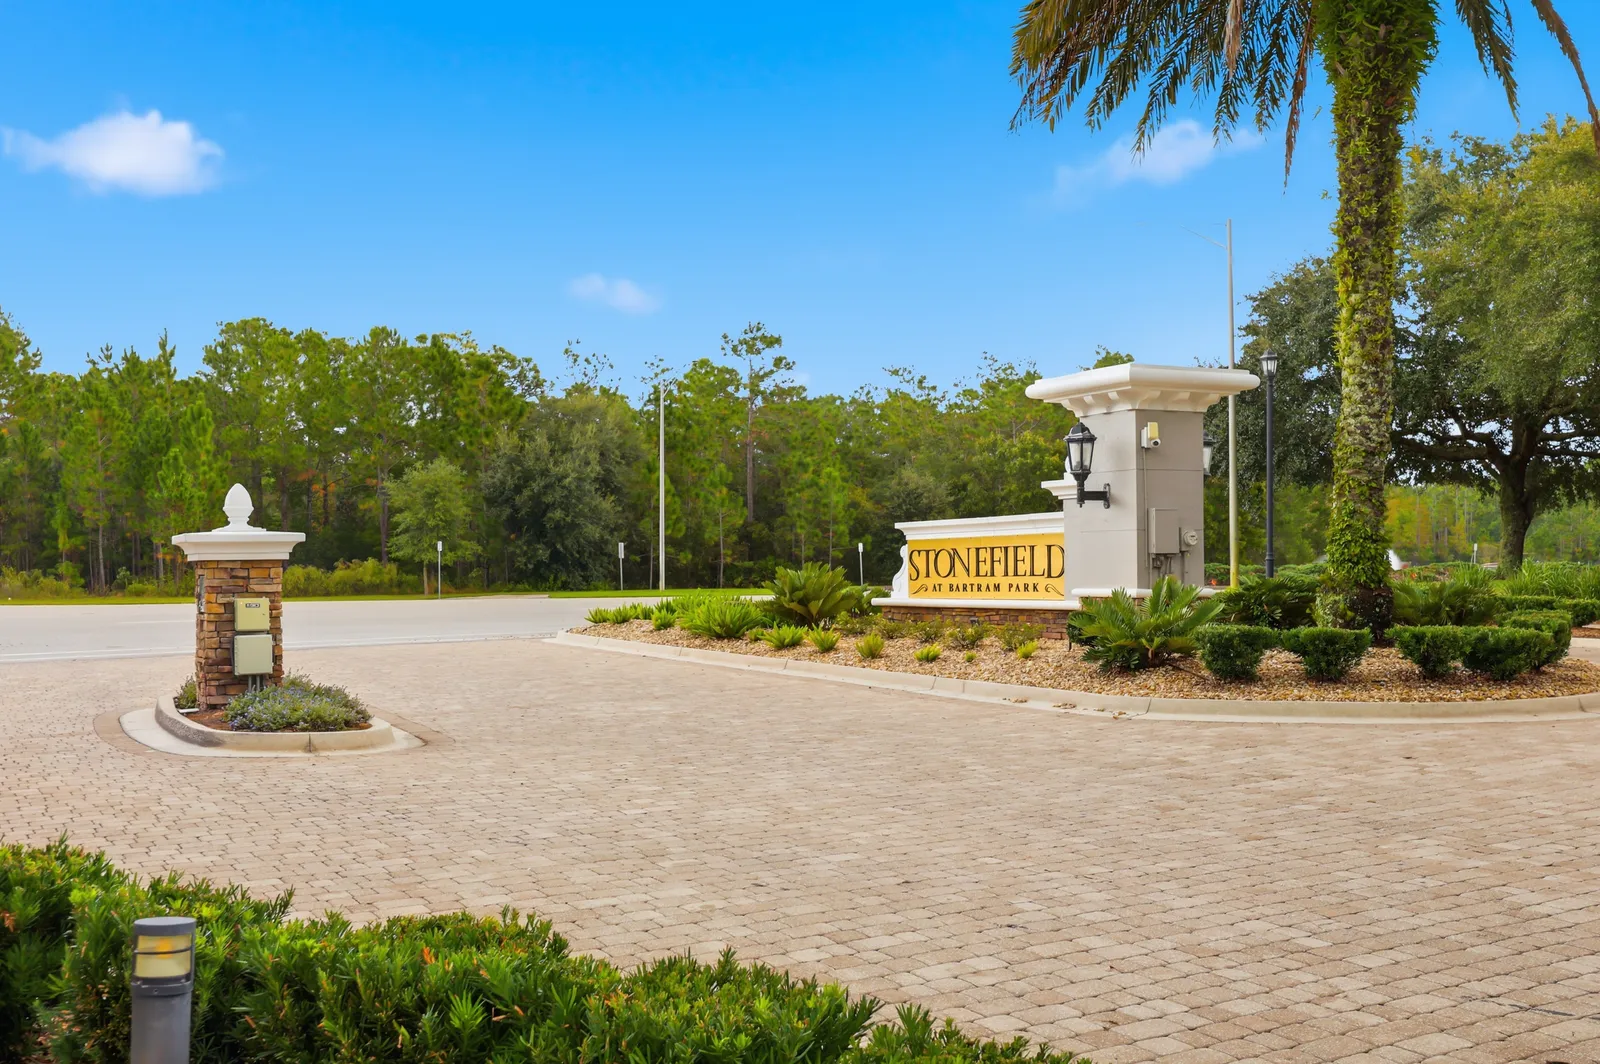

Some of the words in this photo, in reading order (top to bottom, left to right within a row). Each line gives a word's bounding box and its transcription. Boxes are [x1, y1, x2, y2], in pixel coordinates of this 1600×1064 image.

[909, 544, 1064, 581] STONEFIELD
[932, 583, 943, 592] AT
[949, 583, 1001, 592] BARTRAM
[1008, 582, 1040, 592] PARK
